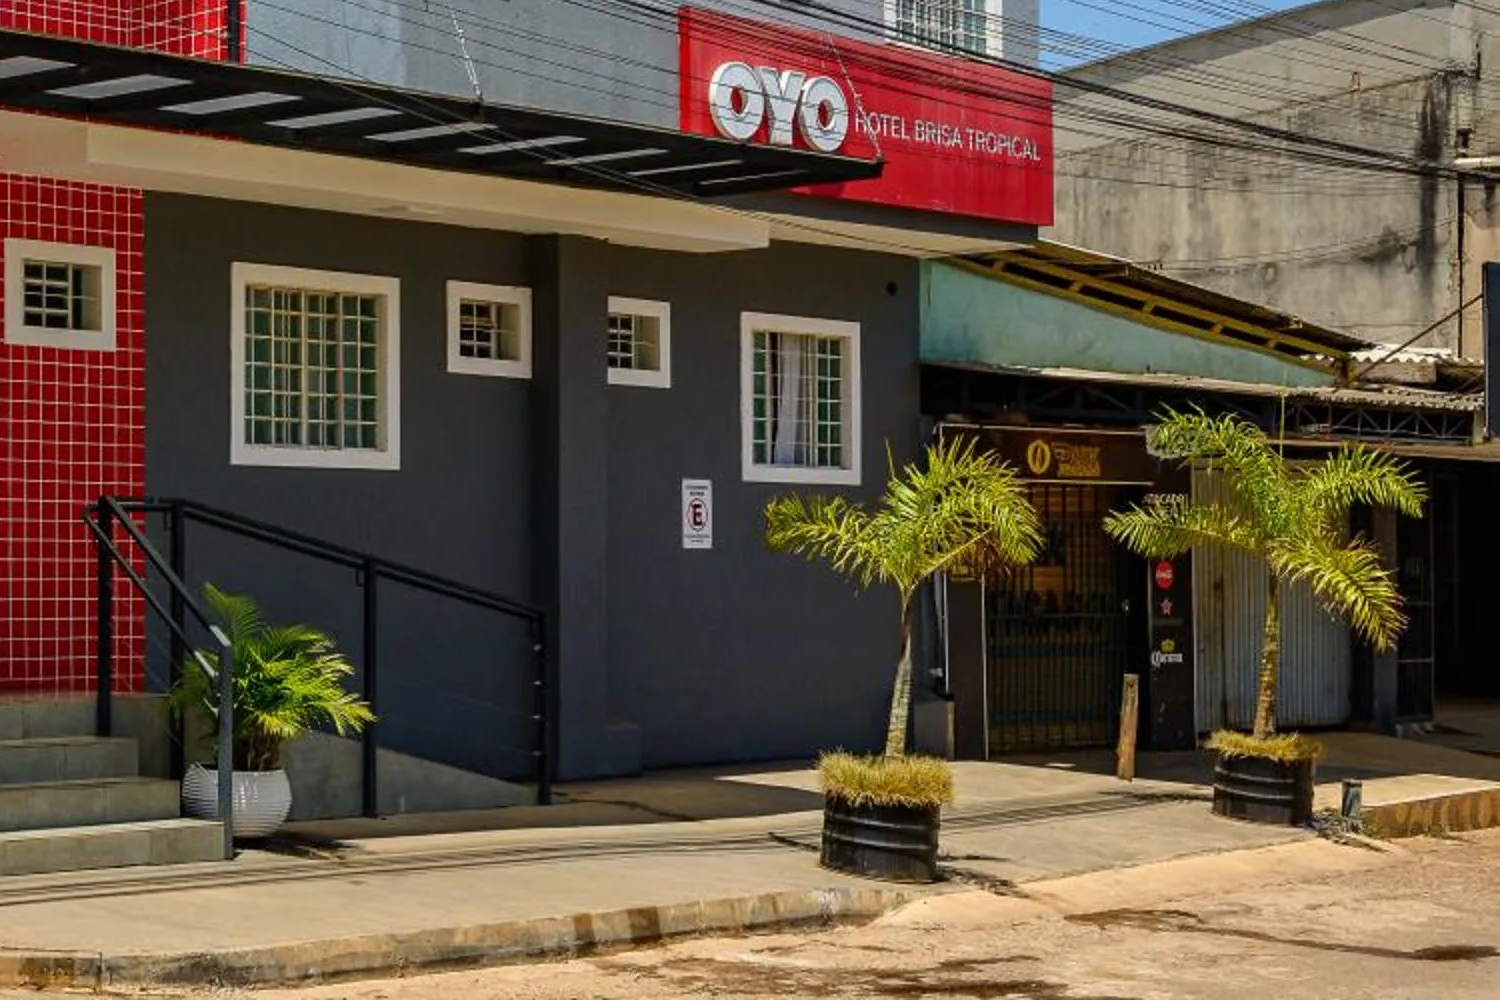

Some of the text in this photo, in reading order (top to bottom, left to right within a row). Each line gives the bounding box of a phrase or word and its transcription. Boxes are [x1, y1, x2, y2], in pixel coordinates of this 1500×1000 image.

[708, 61, 849, 153] OYO
[855, 111, 1041, 161] HOTEL BRISA TROPICAL
